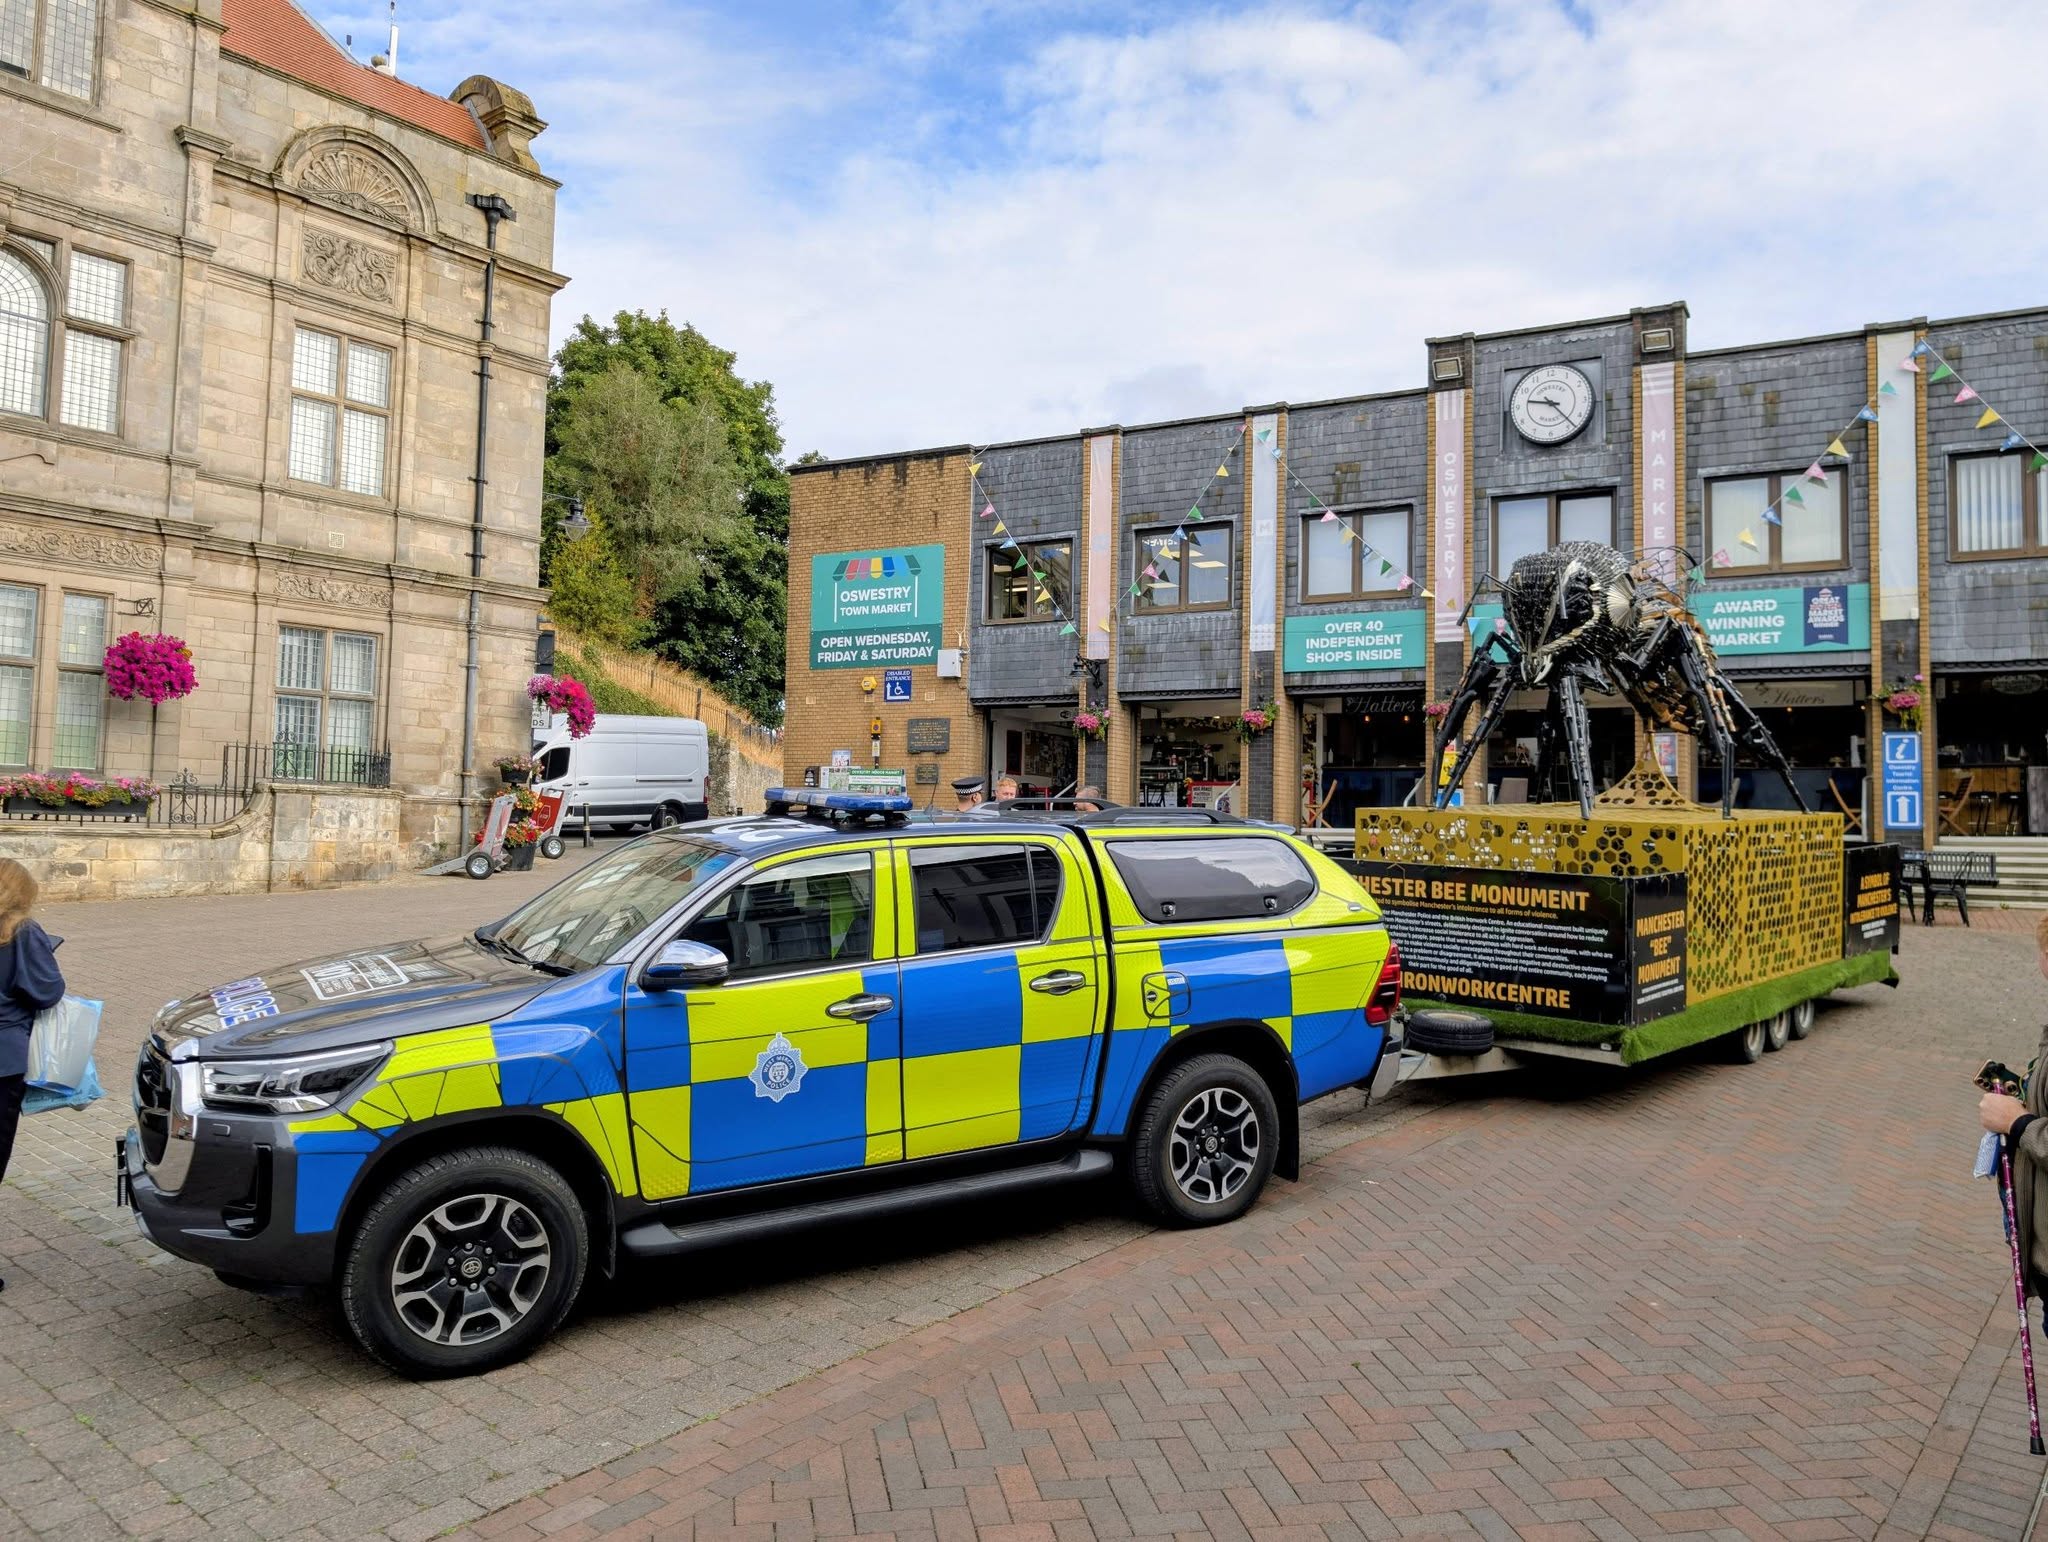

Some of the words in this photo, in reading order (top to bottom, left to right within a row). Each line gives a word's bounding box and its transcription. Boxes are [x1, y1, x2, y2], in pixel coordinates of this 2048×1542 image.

[1442, 452, 1458, 579] OSWESTRY
[840, 586, 911, 602] OSWESTRY
[840, 605, 869, 616] TOWN
[871, 603, 912, 614] MARKET
[1713, 599, 1777, 614] AWARD
[1325, 622, 1362, 634] OVER
[1365, 620, 1384, 632] 40
[1706, 615, 1785, 630] WINNING
[821, 636, 852, 648] OPEN
[855, 631, 931, 646] WEDNESDAY,
[1306, 634, 1403, 649] INDEPENDENT
[1709, 631, 1782, 646] MARKET
[817, 650, 858, 663] FRIDAY
[860, 649, 868, 660] &
[871, 646, 934, 660] SATURDAY
[1306, 651, 1352, 663] SHOPS
[1356, 649, 1402, 661] INSIDE
[1353, 875, 1426, 898] HESTER
[1432, 880, 1467, 901] BEE
[1471, 883, 1590, 912] MONUMENT
[1636, 910, 1685, 937] MANCHESTER
[1638, 956, 1681, 985] MONUMENT
[763, 1057, 776, 1073] WEST
[776, 1055, 794, 1070] MERCIA
[766, 1079, 791, 1089] POLICE
